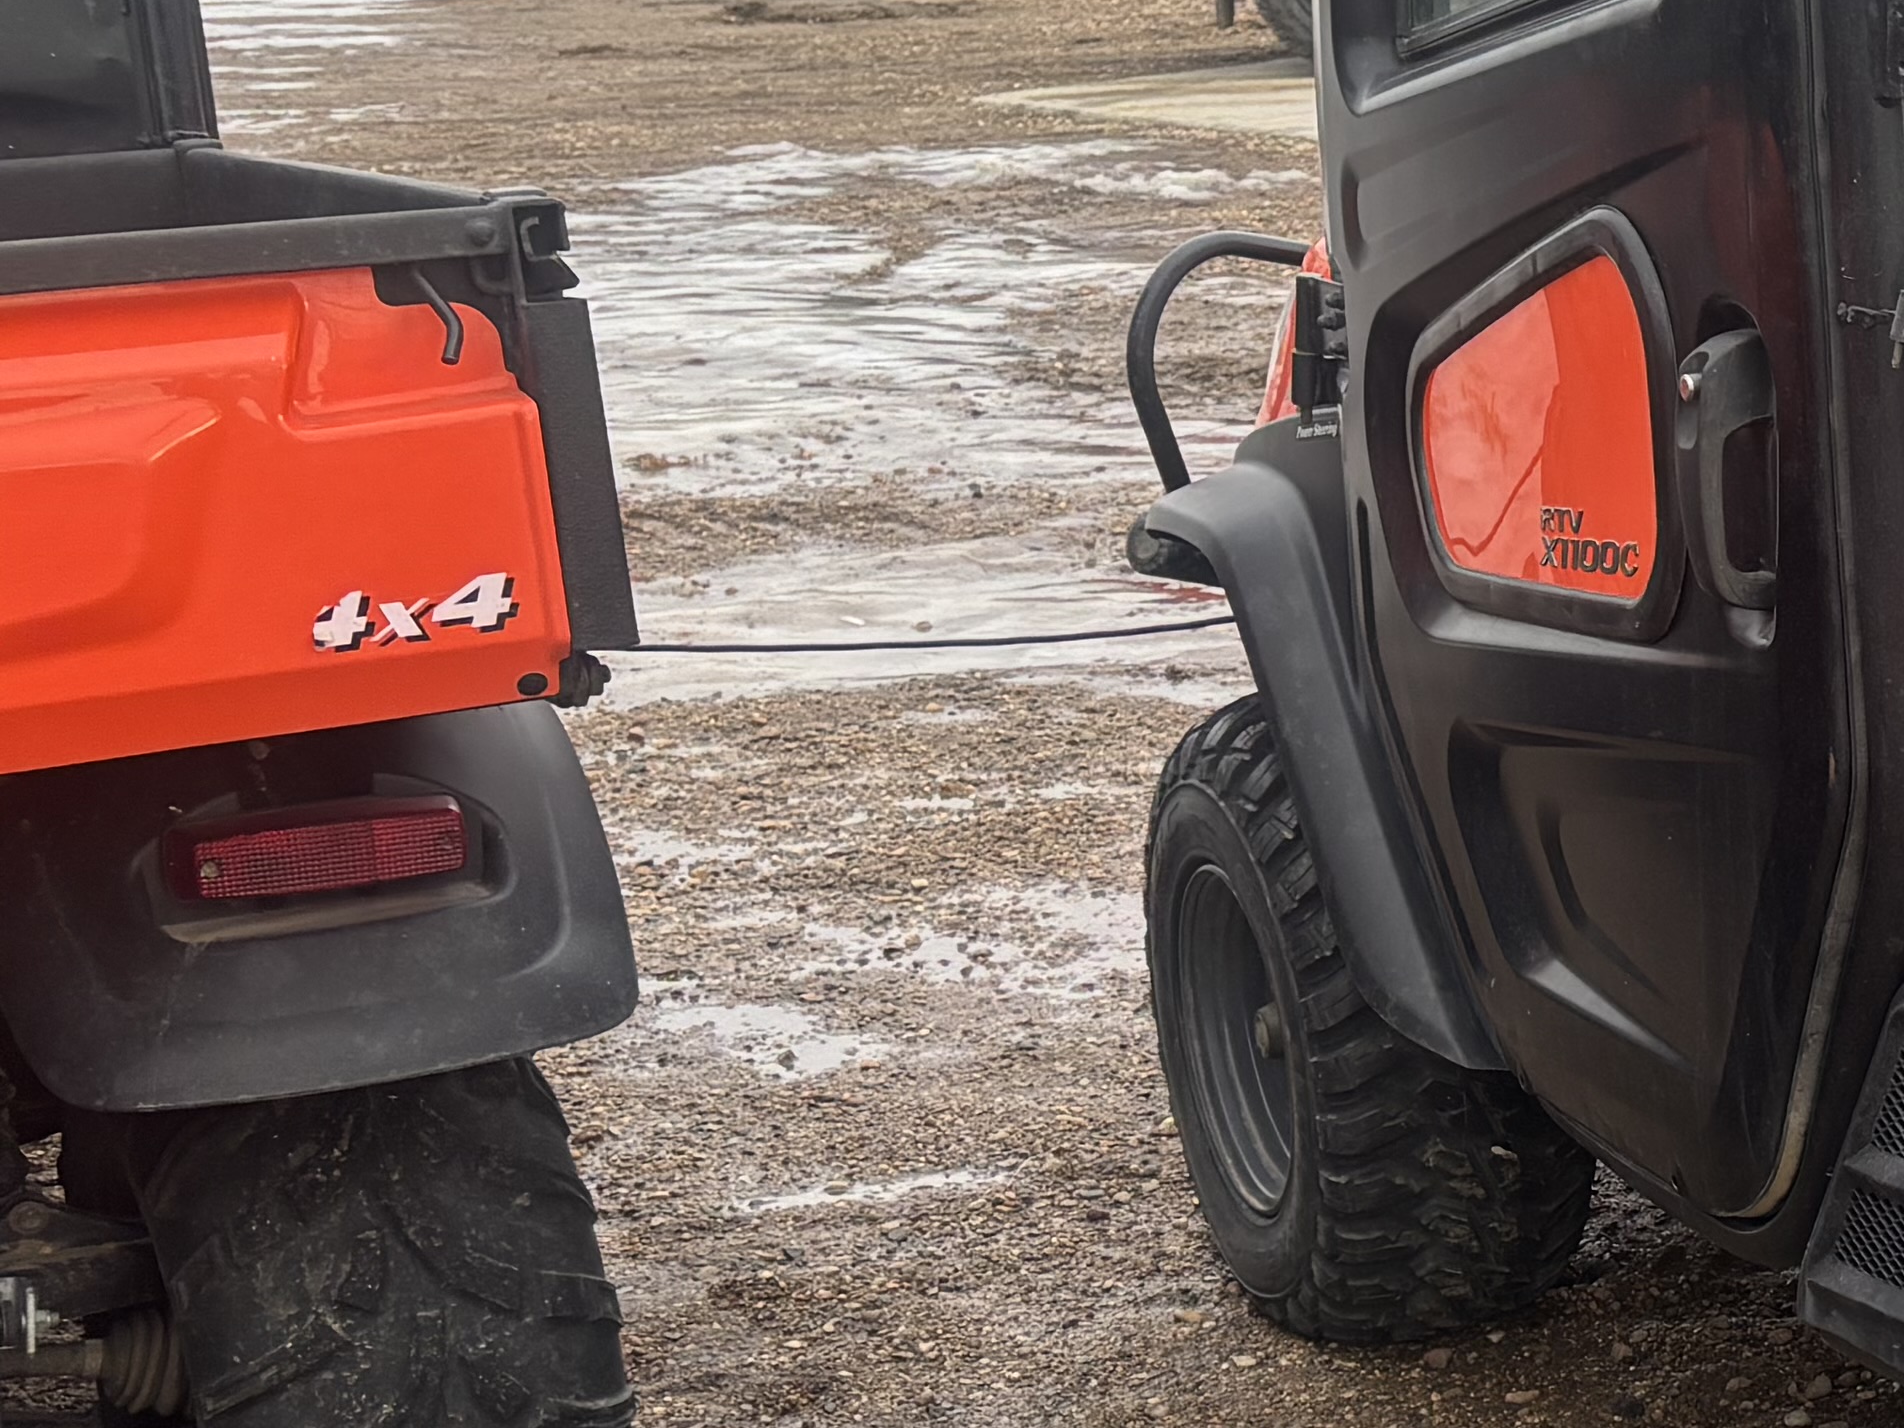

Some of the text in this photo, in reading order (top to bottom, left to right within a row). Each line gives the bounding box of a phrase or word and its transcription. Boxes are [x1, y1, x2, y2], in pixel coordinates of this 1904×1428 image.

[1540, 507, 1584, 535] RTV
[1540, 536, 1640, 577] X1100C
[312, 572, 520, 653] 4x4
